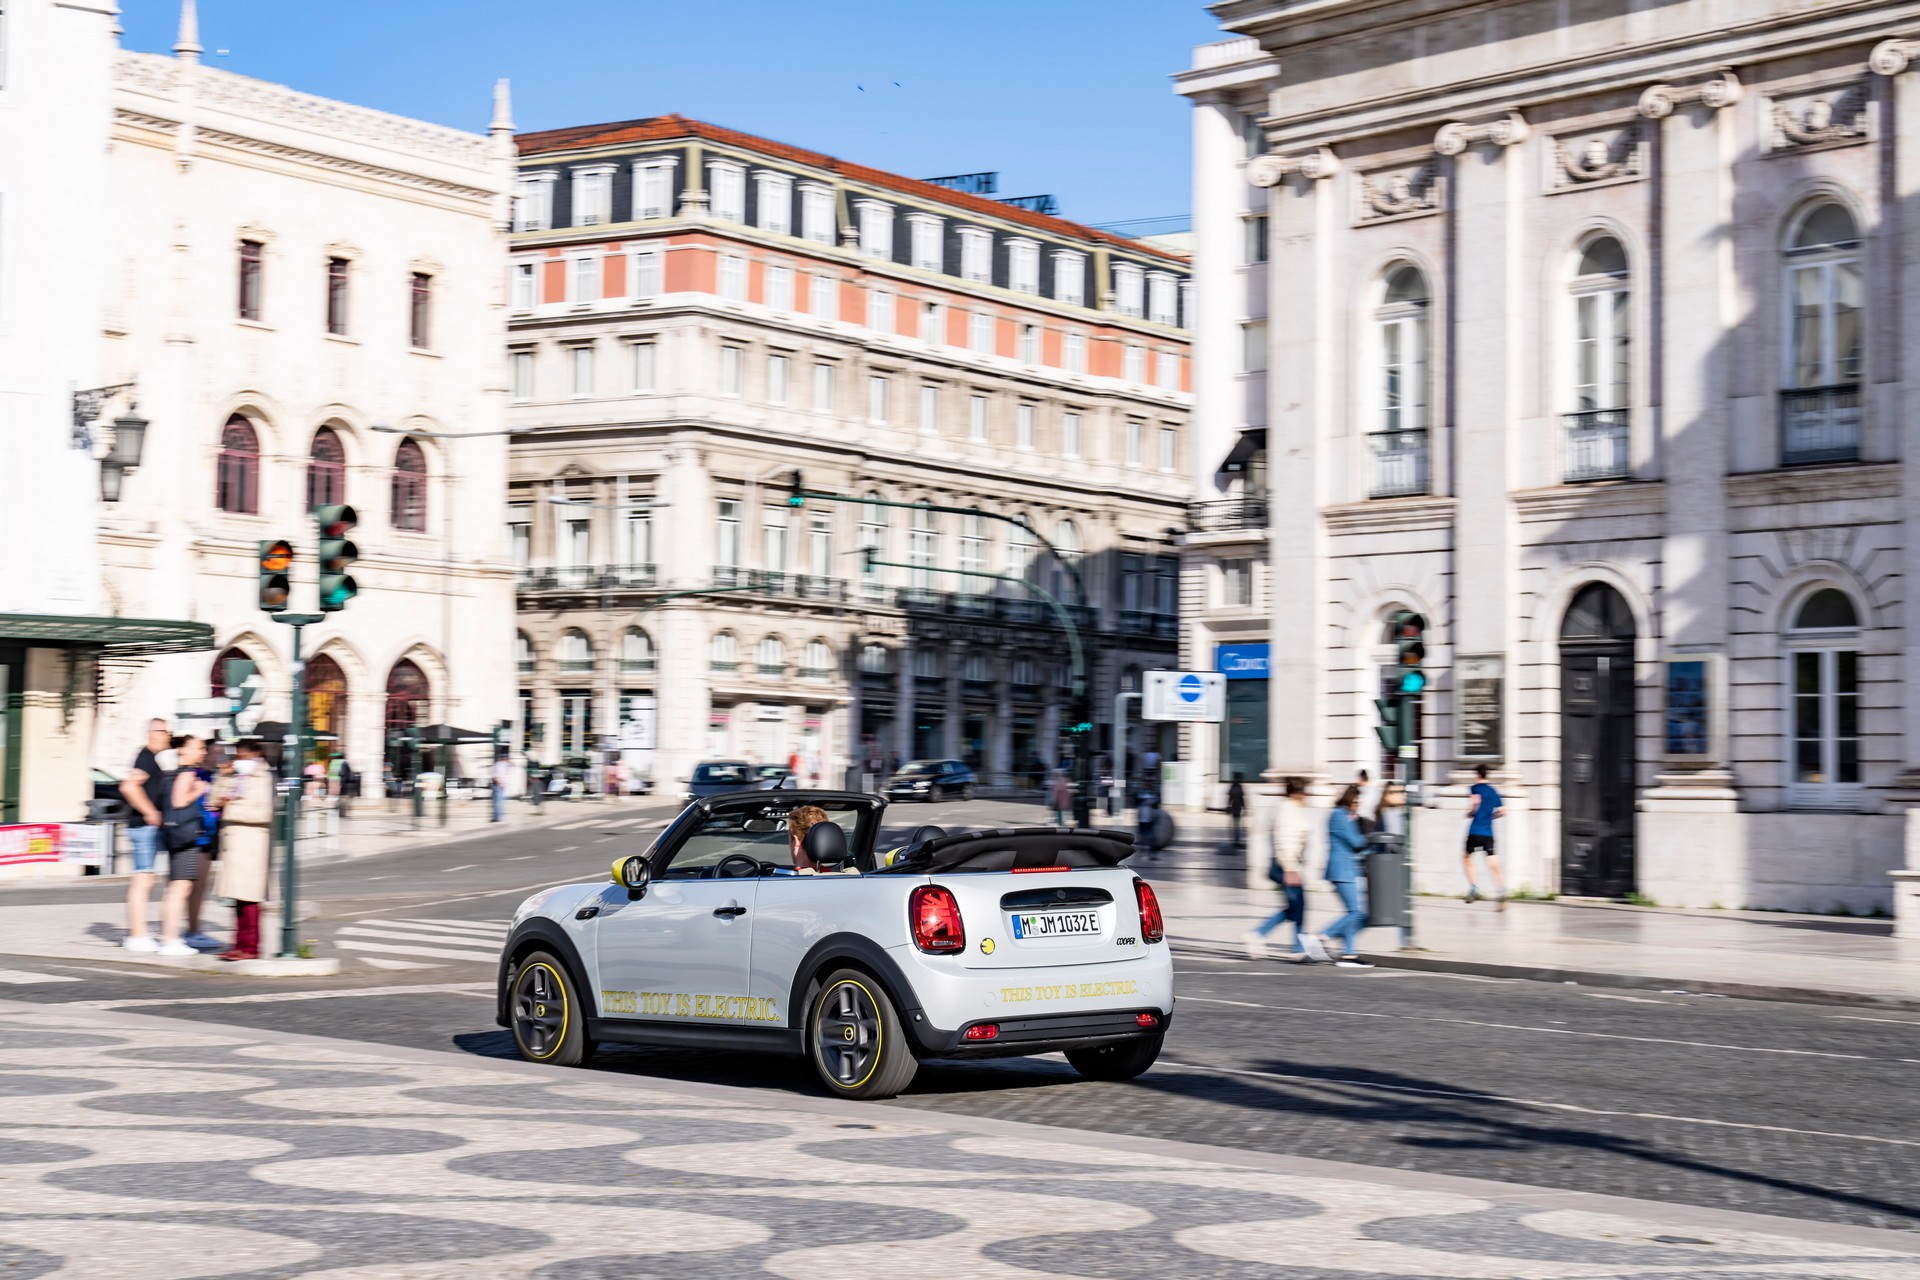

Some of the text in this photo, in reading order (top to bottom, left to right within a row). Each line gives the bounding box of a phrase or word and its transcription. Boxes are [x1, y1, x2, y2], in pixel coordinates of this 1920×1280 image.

[1116, 937, 1136, 945] COOPER
[1001, 987, 1032, 1002] THIS
[1035, 985, 1062, 1000] TOY
[1065, 984, 1077, 999] IS
[601, 990, 780, 1021] THIS TOY IS ELECTRIC.
